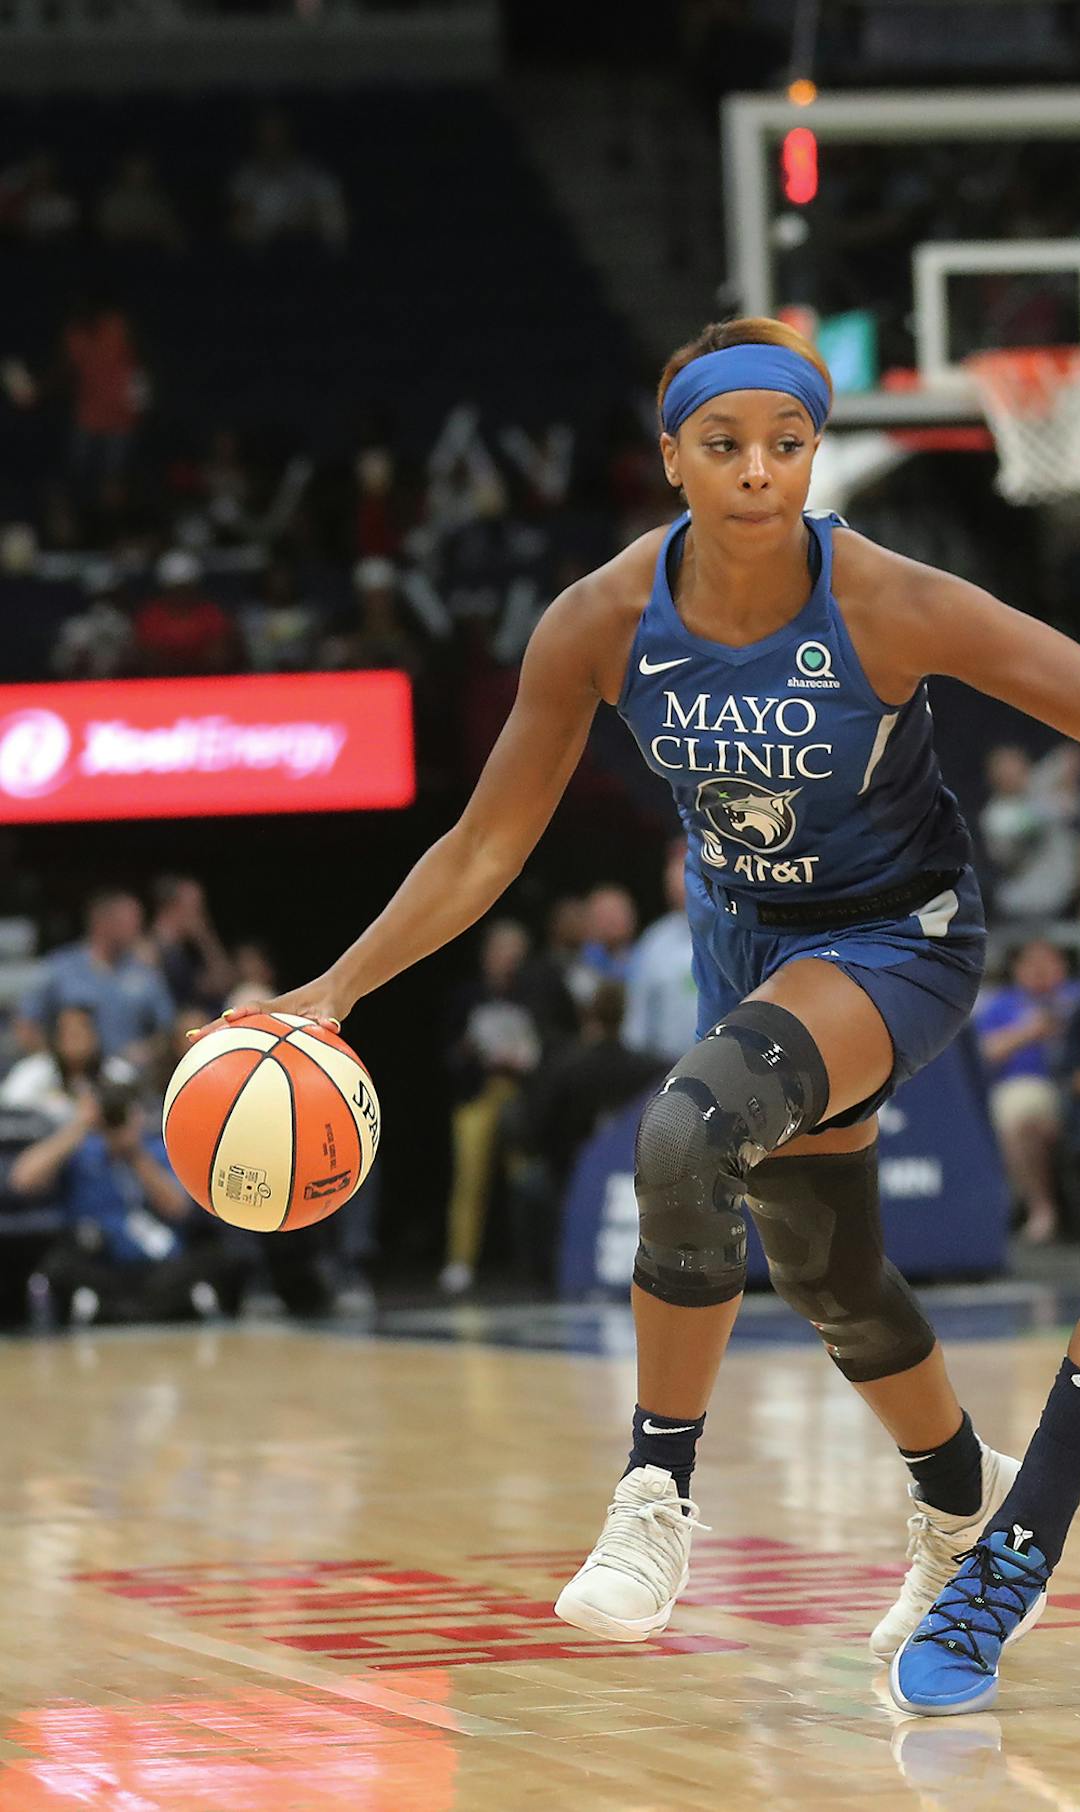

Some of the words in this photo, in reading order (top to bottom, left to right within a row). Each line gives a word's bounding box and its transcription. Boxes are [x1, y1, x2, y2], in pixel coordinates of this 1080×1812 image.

[787, 677, 840, 689] sharecare
[662, 691, 817, 737] MAYO
[651, 735, 833, 779] CLINIC
[734, 855, 820, 883] AT&T
[352, 1080, 379, 1158] SPA
